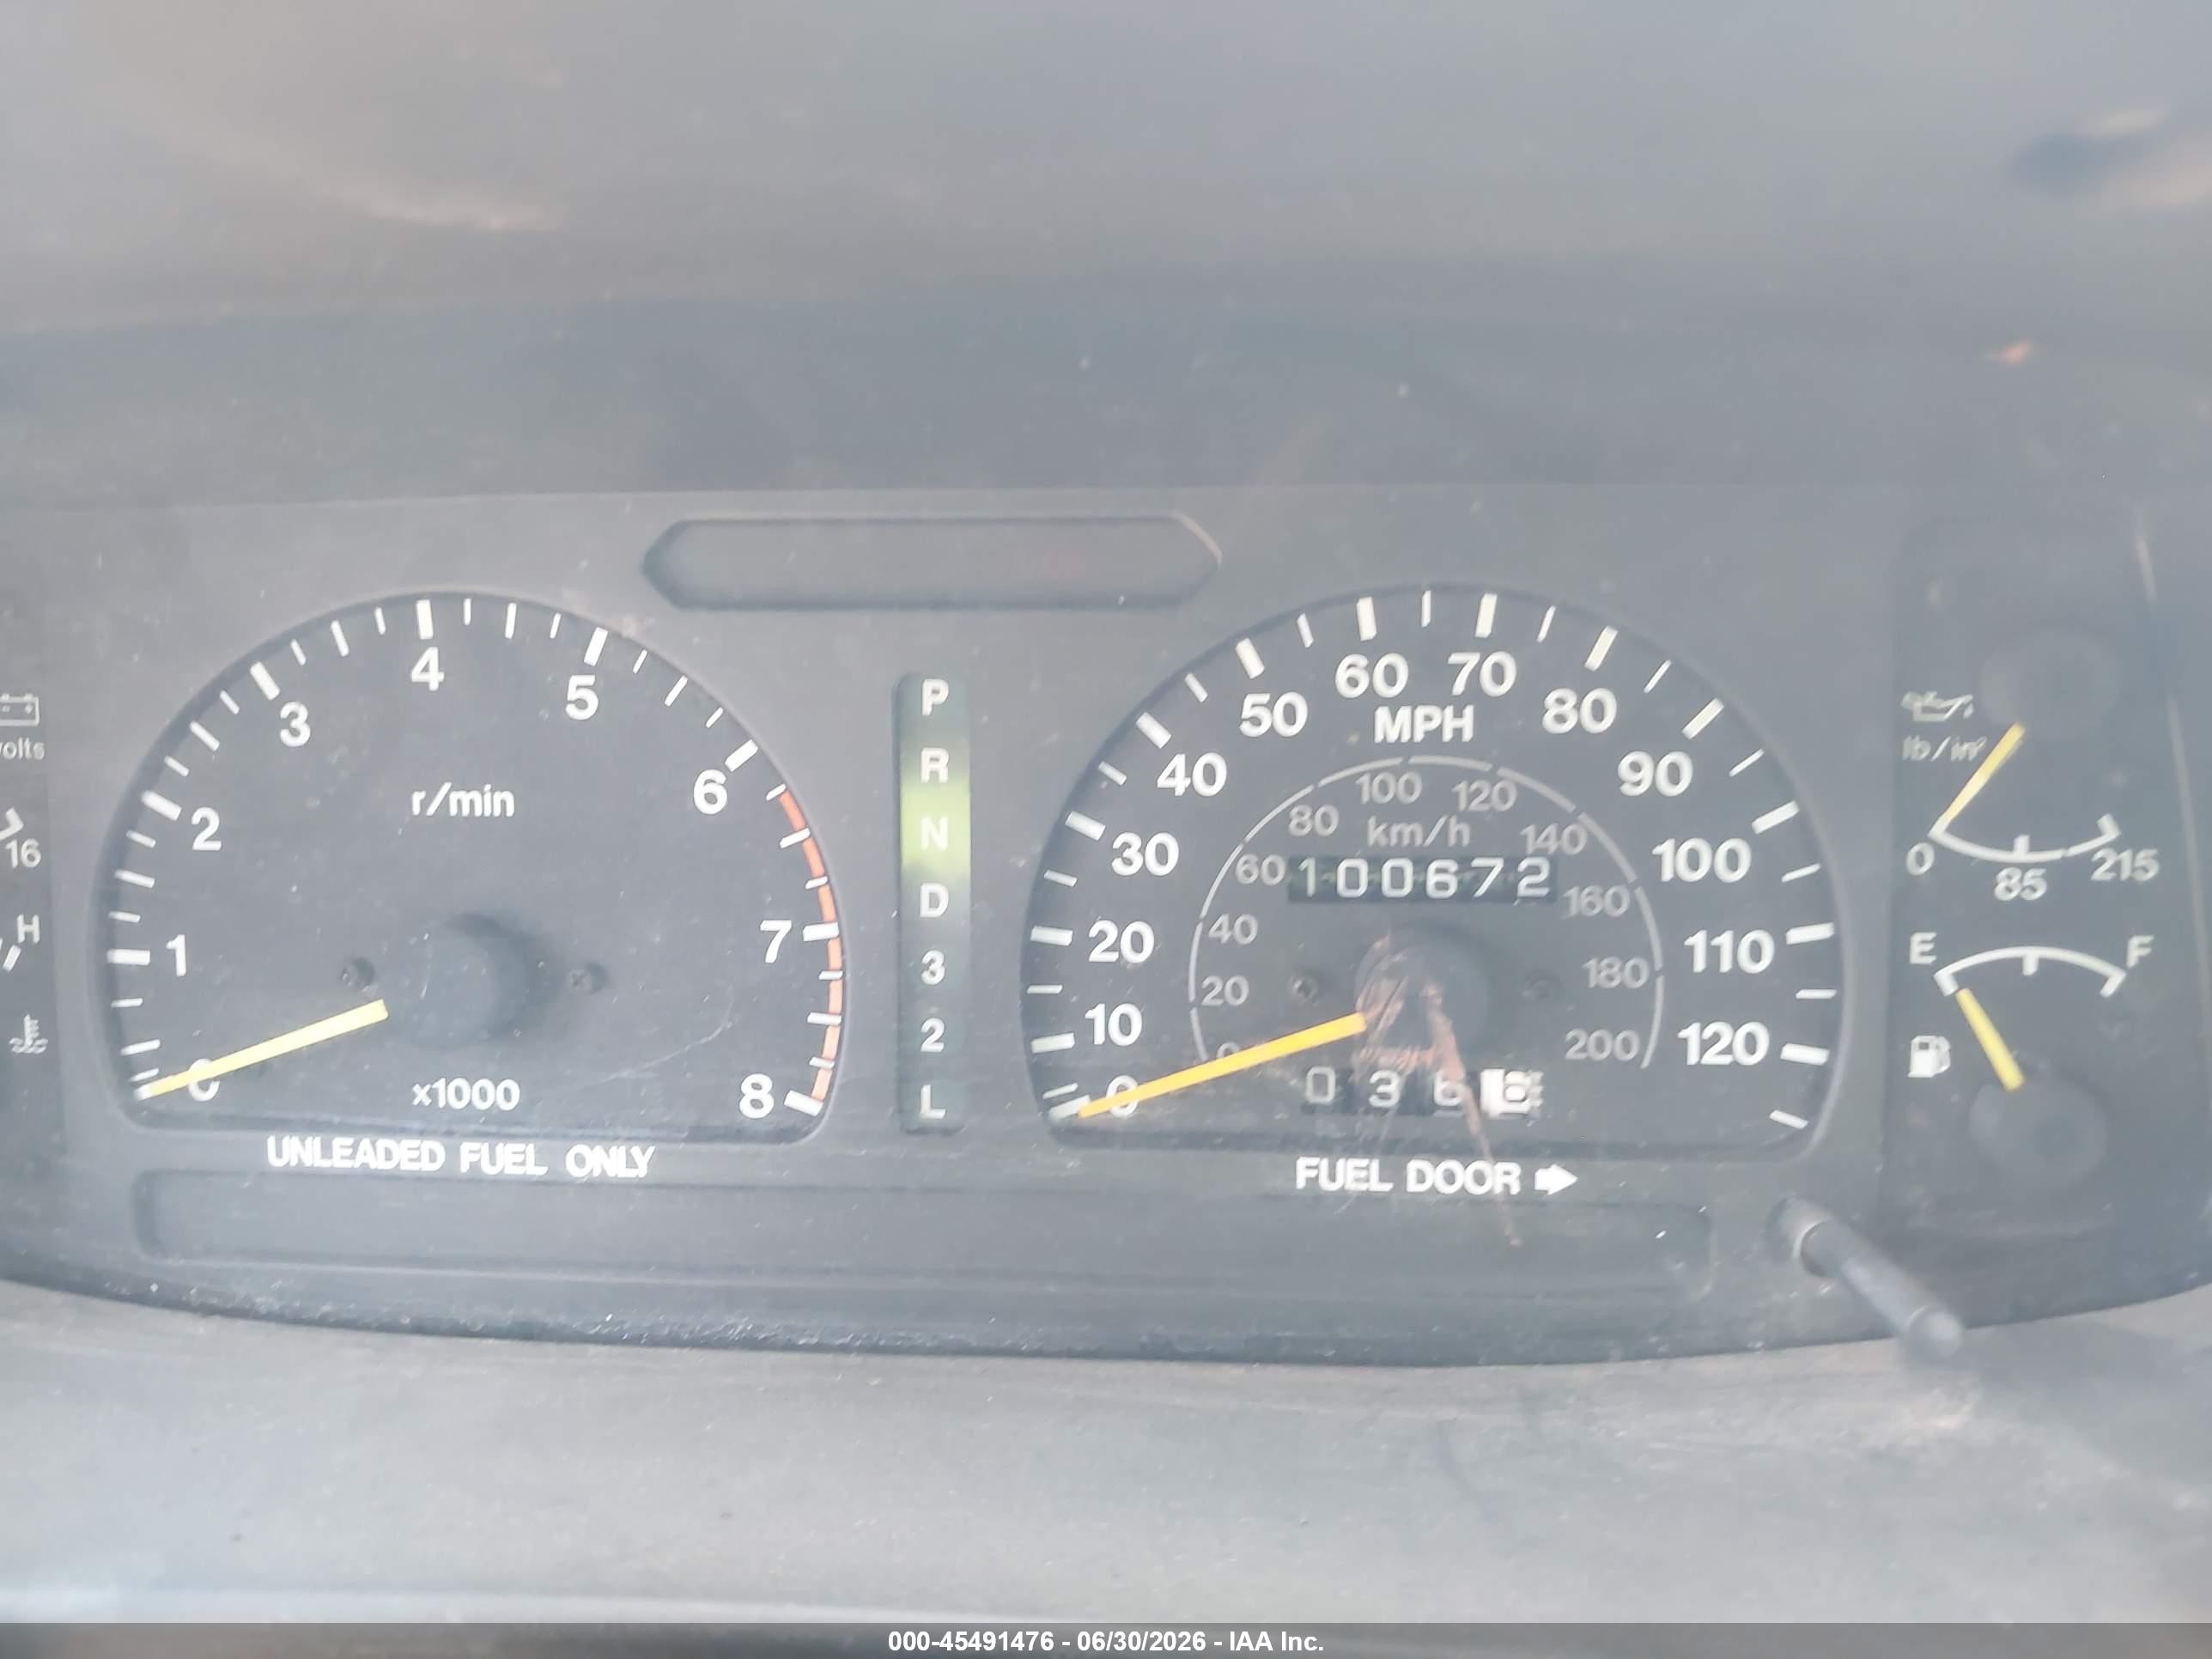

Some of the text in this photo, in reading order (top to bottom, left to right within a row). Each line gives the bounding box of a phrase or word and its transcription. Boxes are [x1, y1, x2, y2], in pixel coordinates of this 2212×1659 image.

[411, 647, 445, 691] 4
[1334, 653, 1409, 698] 60
[1448, 651, 1517, 696] 70
[565, 675, 599, 720] 5
[921, 678, 949, 715] P
[1239, 692, 1308, 737] 50
[1541, 687, 1617, 734] 80
[279, 702, 312, 748] 3
[1374, 705, 1474, 744] MPH
[0, 737, 45, 760] olts
[921, 747, 949, 783] R
[693, 769, 727, 814] 6
[1157, 752, 1228, 796] 40
[1356, 772, 1422, 805] 100
[1618, 750, 1694, 797] 90
[411, 781, 515, 818] r/min
[1451, 779, 1517, 812] 120
[191, 806, 222, 851] 2
[921, 816, 948, 851] N
[1289, 805, 1340, 836] 80
[1368, 815, 1470, 848] km/h
[6, 838, 41, 868] 16
[1111, 831, 1179, 875] 30
[1519, 823, 1588, 857] 140
[1235, 854, 1286, 886] 60
[1297, 856, 1551, 898] 100672
[1651, 838, 1752, 883] 100
[1905, 842, 1935, 876] 0
[2090, 848, 2160, 882] 215
[920, 884, 948, 918] D
[1562, 885, 1630, 918] 160
[1993, 866, 2048, 902] 85
[16, 915, 40, 944] H
[759, 920, 793, 963] 7
[1088, 920, 1155, 963] 20
[1207, 914, 1259, 945] 40
[166, 934, 187, 976] 1
[1684, 929, 1775, 974] 110
[1909, 932, 1937, 965] E
[2126, 935, 2154, 969] F
[921, 951, 946, 985] 3
[1583, 957, 1650, 989] 180
[1201, 975, 1249, 1006] 20
[921, 1018, 945, 1052] 2
[1085, 1002, 1143, 1047] 10
[1565, 1029, 1640, 1061] 200
[1677, 1021, 1770, 1066] 120
[411, 1079, 520, 1110] x1000
[739, 1073, 775, 1119] 8
[921, 1084, 946, 1120] L
[266, 1135, 656, 1179] UNLEADED FUEL ONLY
[1295, 1156, 1522, 1195] FUEL DOOR
